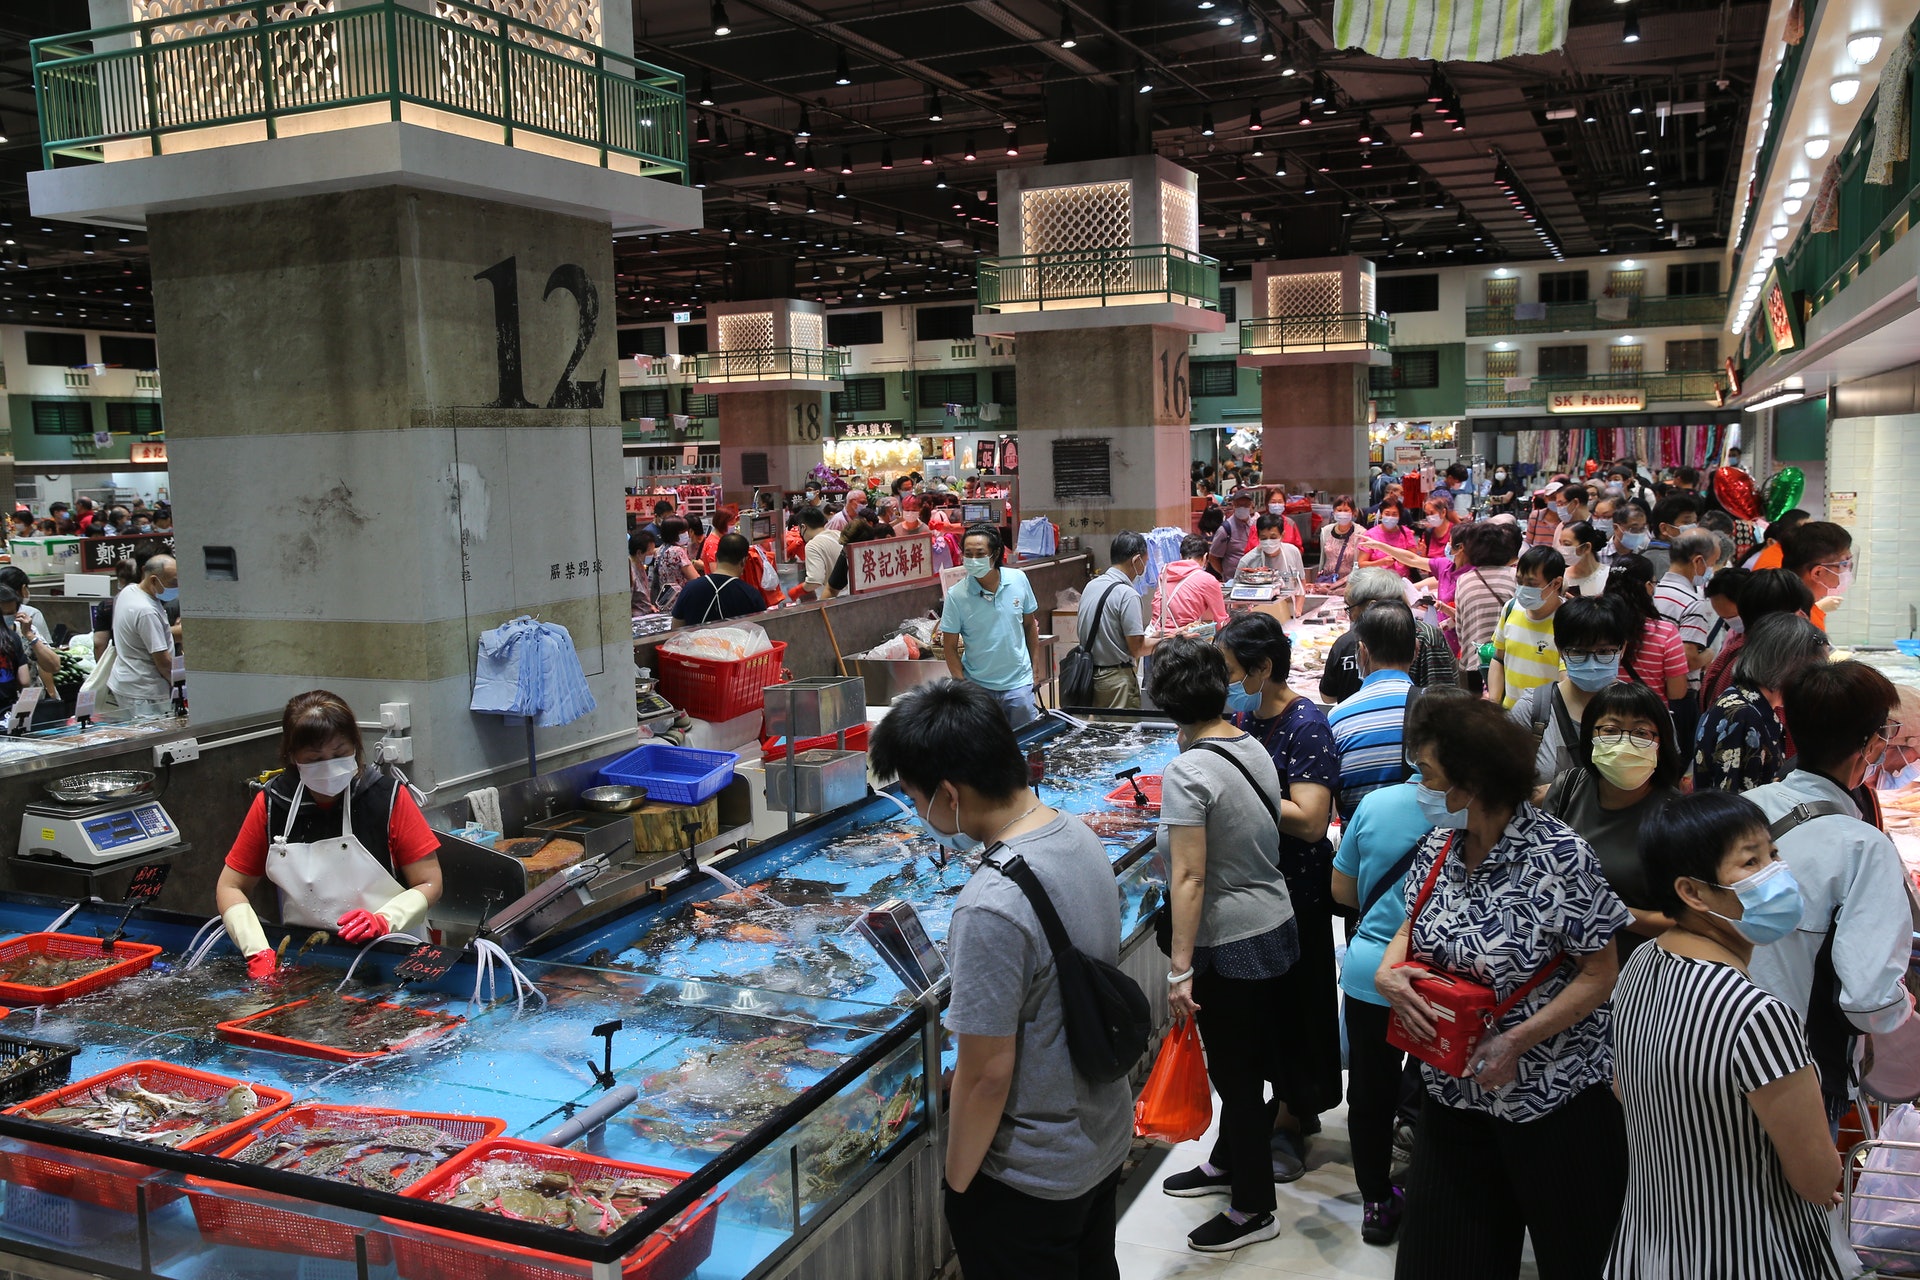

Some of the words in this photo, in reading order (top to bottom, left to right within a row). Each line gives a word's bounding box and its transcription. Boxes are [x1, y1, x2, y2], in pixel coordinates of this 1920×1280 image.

[473, 256, 606, 409] 12
[1159, 349, 1187, 419] 16
[1554, 395, 1573, 407] SK
[1582, 393, 1639, 406] Fashion
[794, 402, 821, 441] 18
[550, 560, 603, 580] 嚴禁踢球
[862, 543, 925, 583] 榮記海鮮
